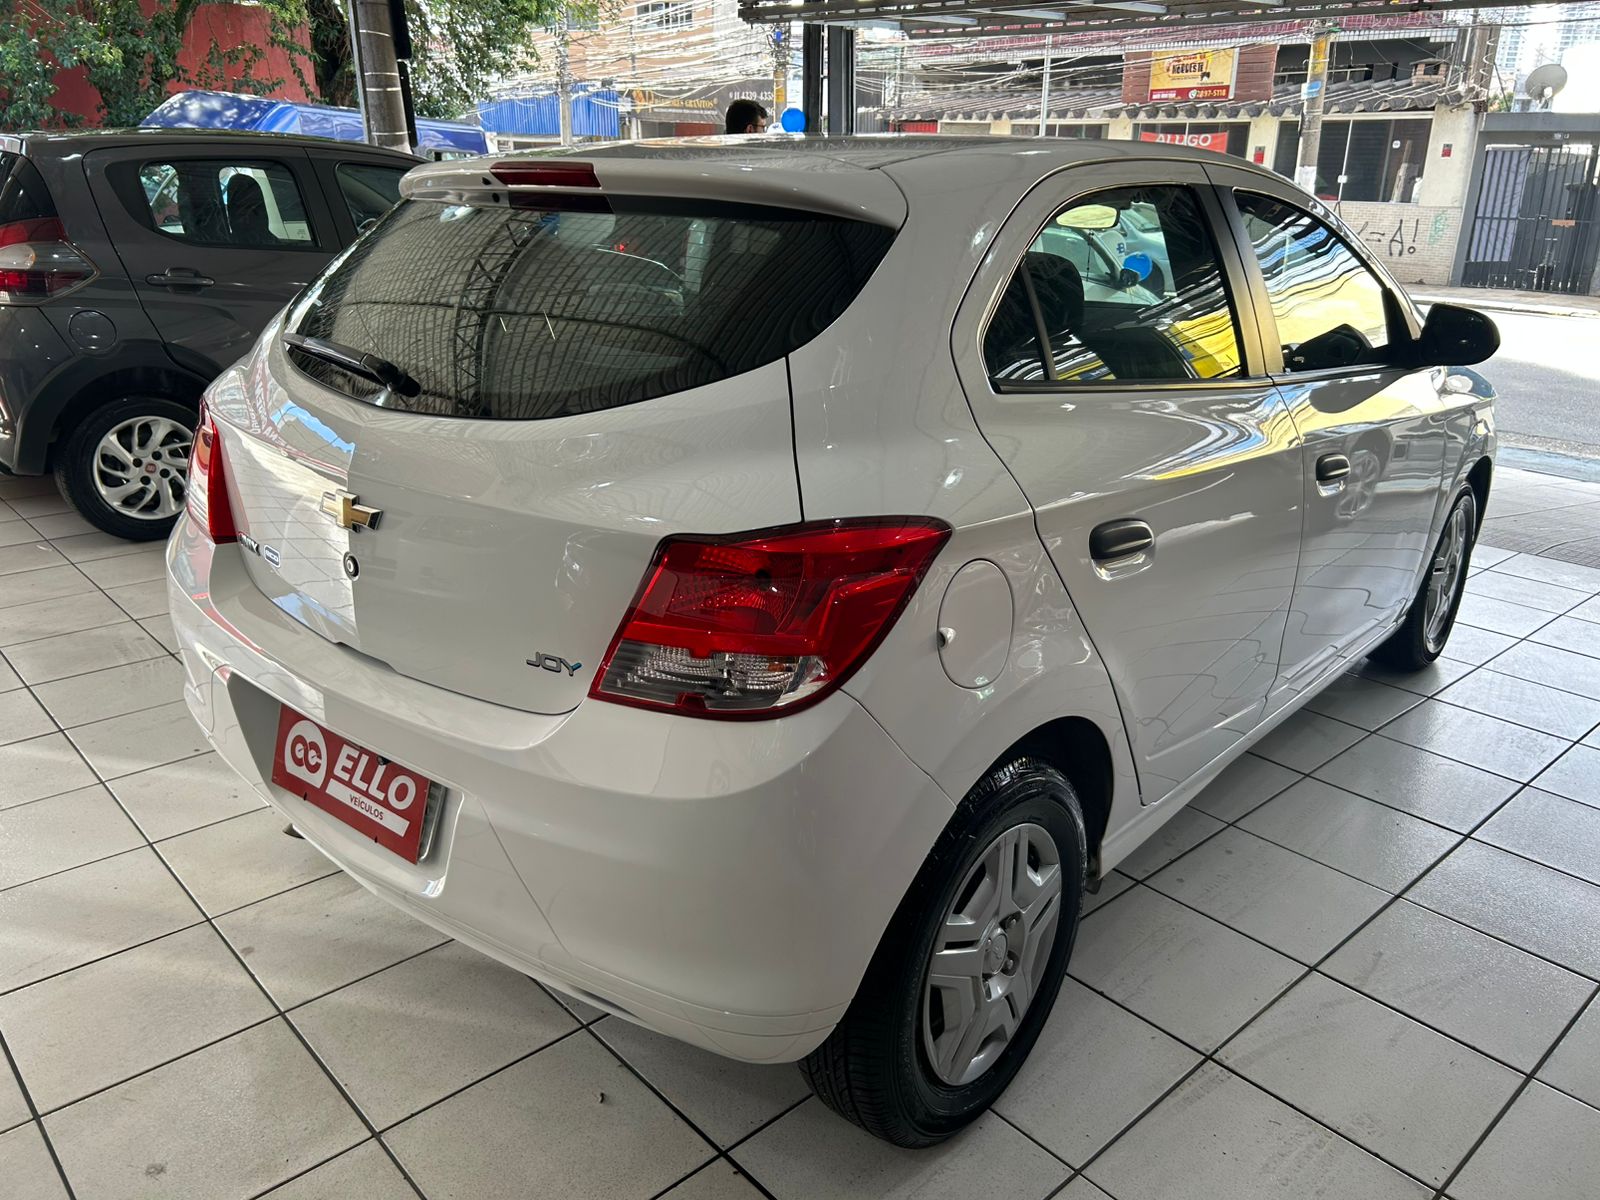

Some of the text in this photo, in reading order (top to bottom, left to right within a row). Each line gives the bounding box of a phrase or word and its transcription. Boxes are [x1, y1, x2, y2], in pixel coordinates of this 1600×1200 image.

[526, 651, 582, 677] JOY
[333, 744, 416, 811] ELLO
[350, 794, 384, 821] VEÍCULOS
